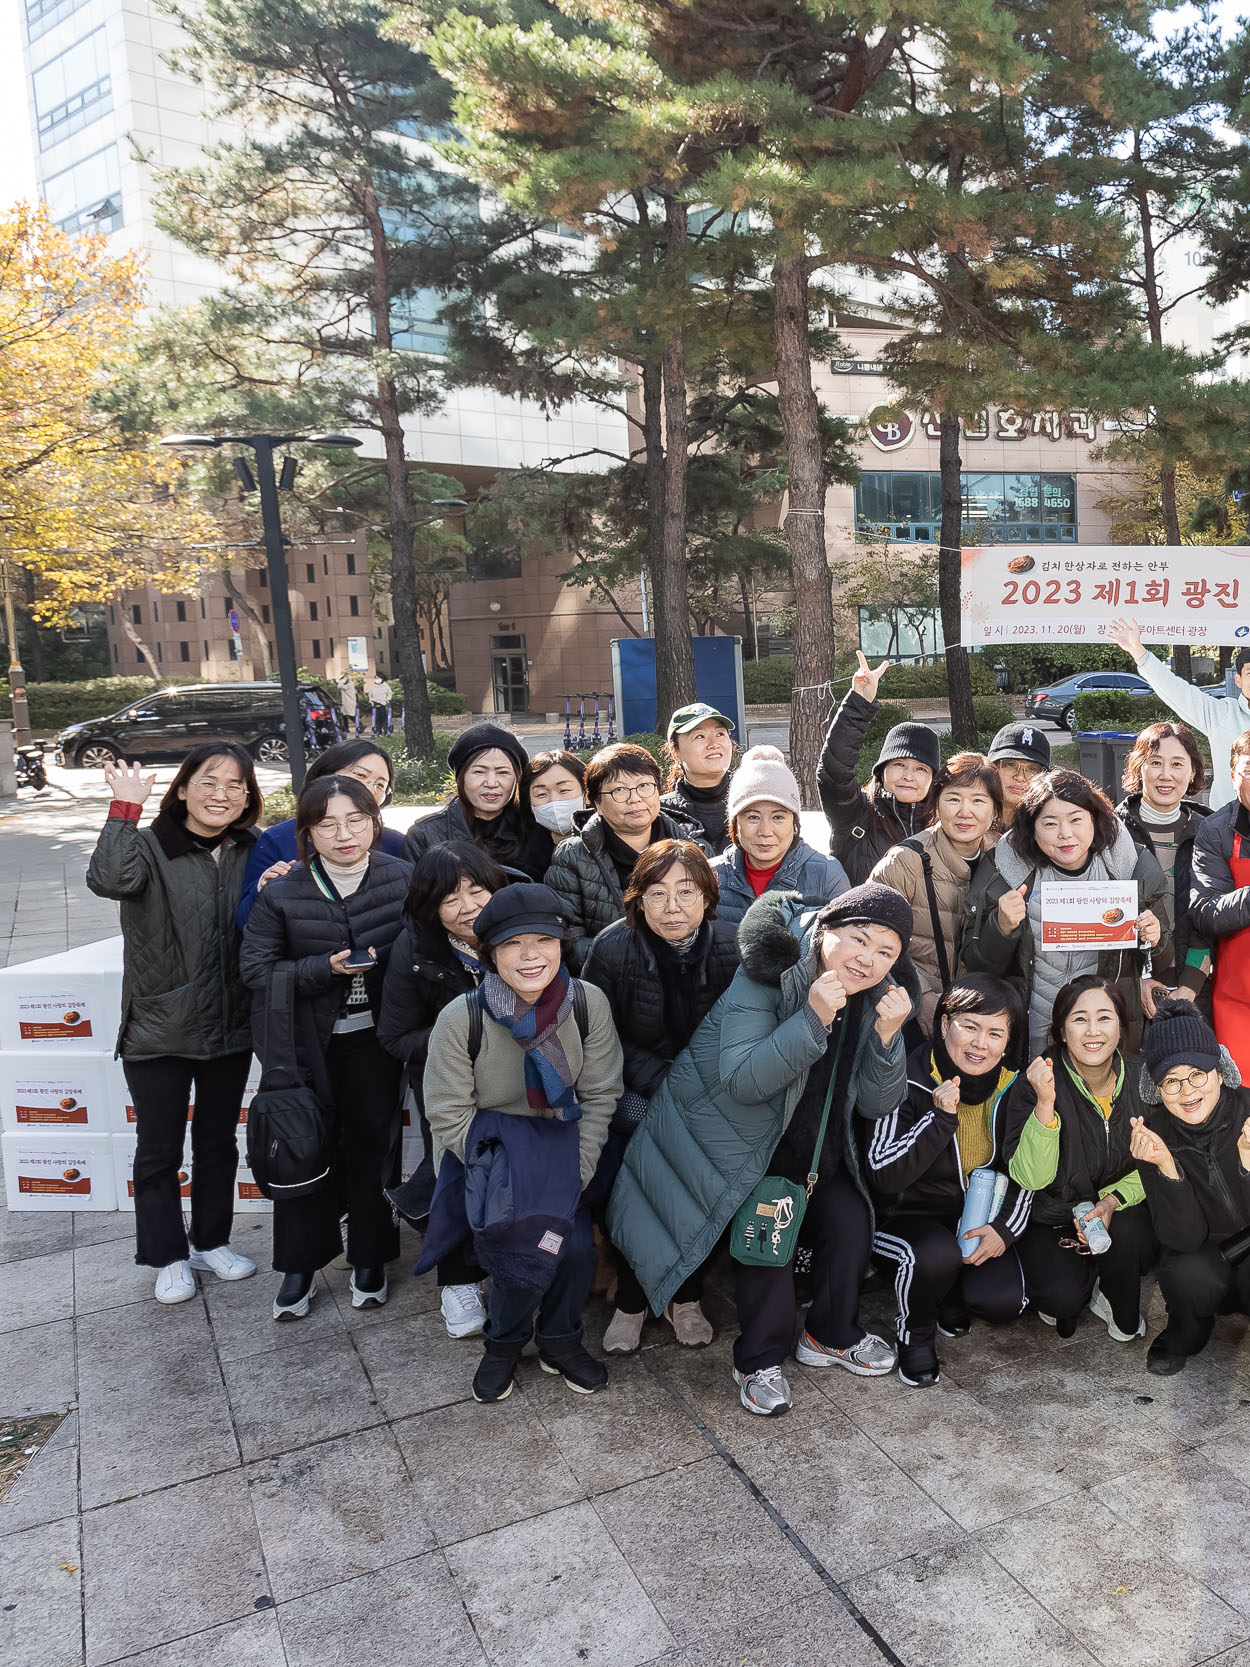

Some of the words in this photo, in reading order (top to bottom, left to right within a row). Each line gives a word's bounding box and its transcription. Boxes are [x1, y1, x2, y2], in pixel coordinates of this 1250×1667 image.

[1043, 487, 1062, 498] 문의
[1015, 498, 1038, 508] 1688
[1044, 498, 1070, 508] 4650
[1041, 561, 1060, 571] 김치
[1064, 561, 1108, 571] 한상자로
[1112, 561, 1144, 571] 전하는
[1148, 561, 1169, 572] 안부
[1001, 579, 1081, 605] 2023
[1091, 578, 1169, 608] 제1회
[1181, 578, 1240, 609] 광진
[1057, 624, 1087, 635] 20(월)
[1188, 626, 1208, 637] 광장
